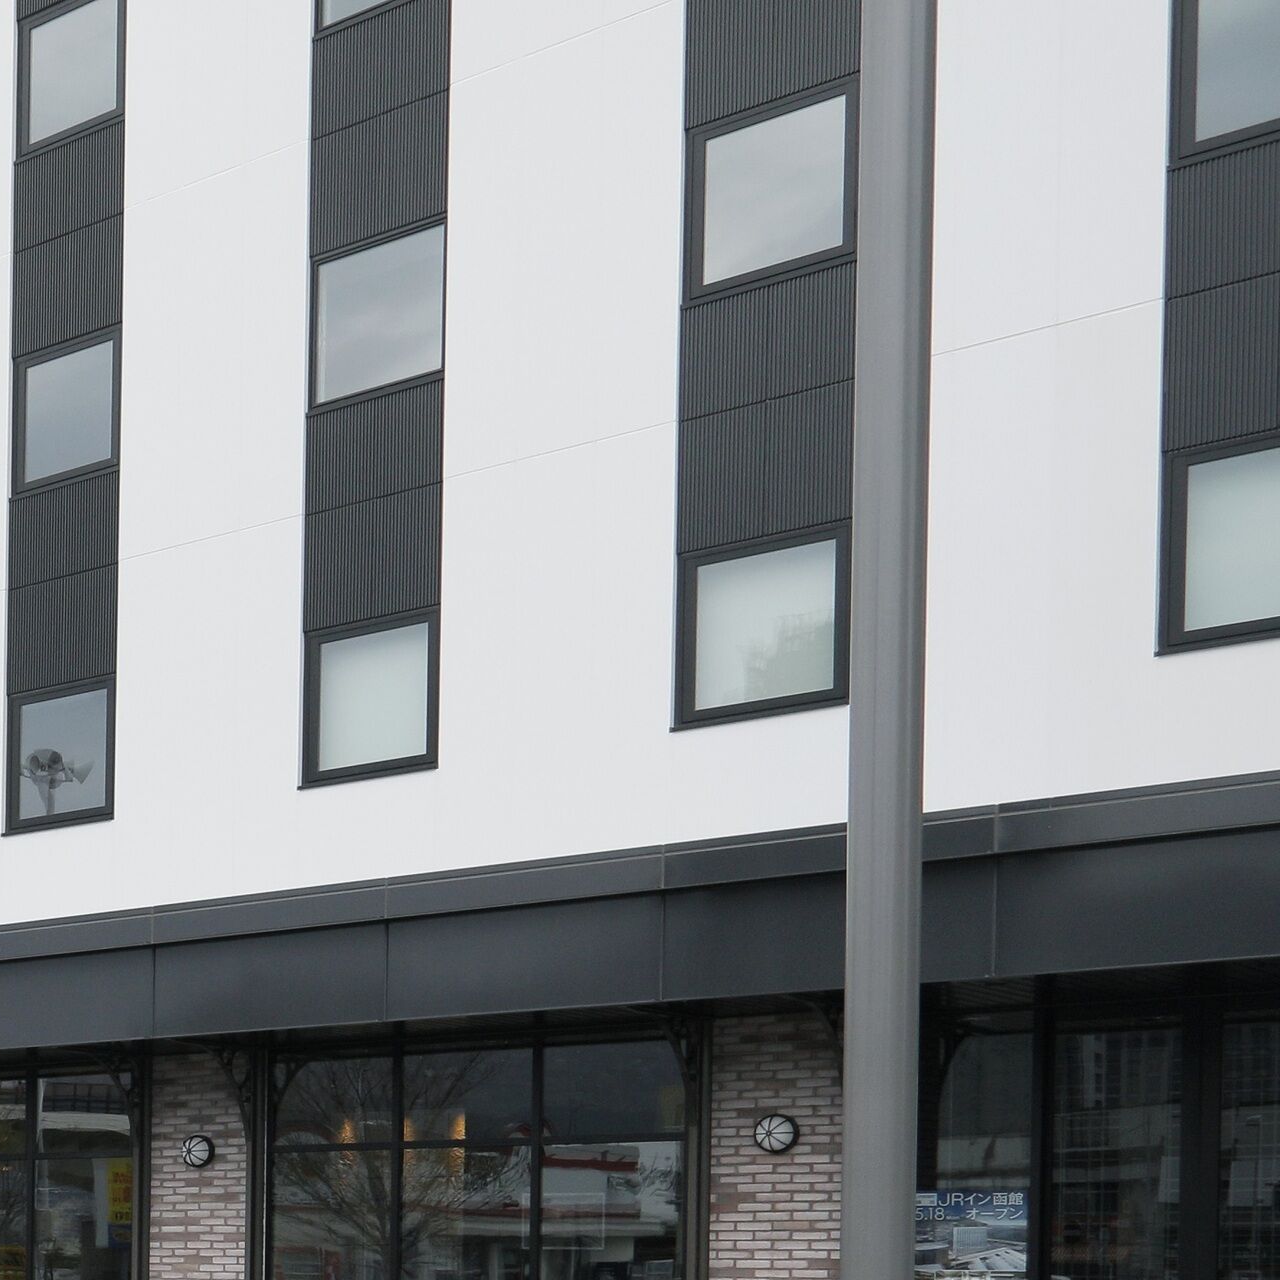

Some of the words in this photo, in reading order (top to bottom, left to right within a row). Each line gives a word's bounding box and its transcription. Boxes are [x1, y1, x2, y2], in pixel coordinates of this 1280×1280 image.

[915, 1207, 945, 1221] 5.18
[966, 1207, 1024, 1220] オープン
